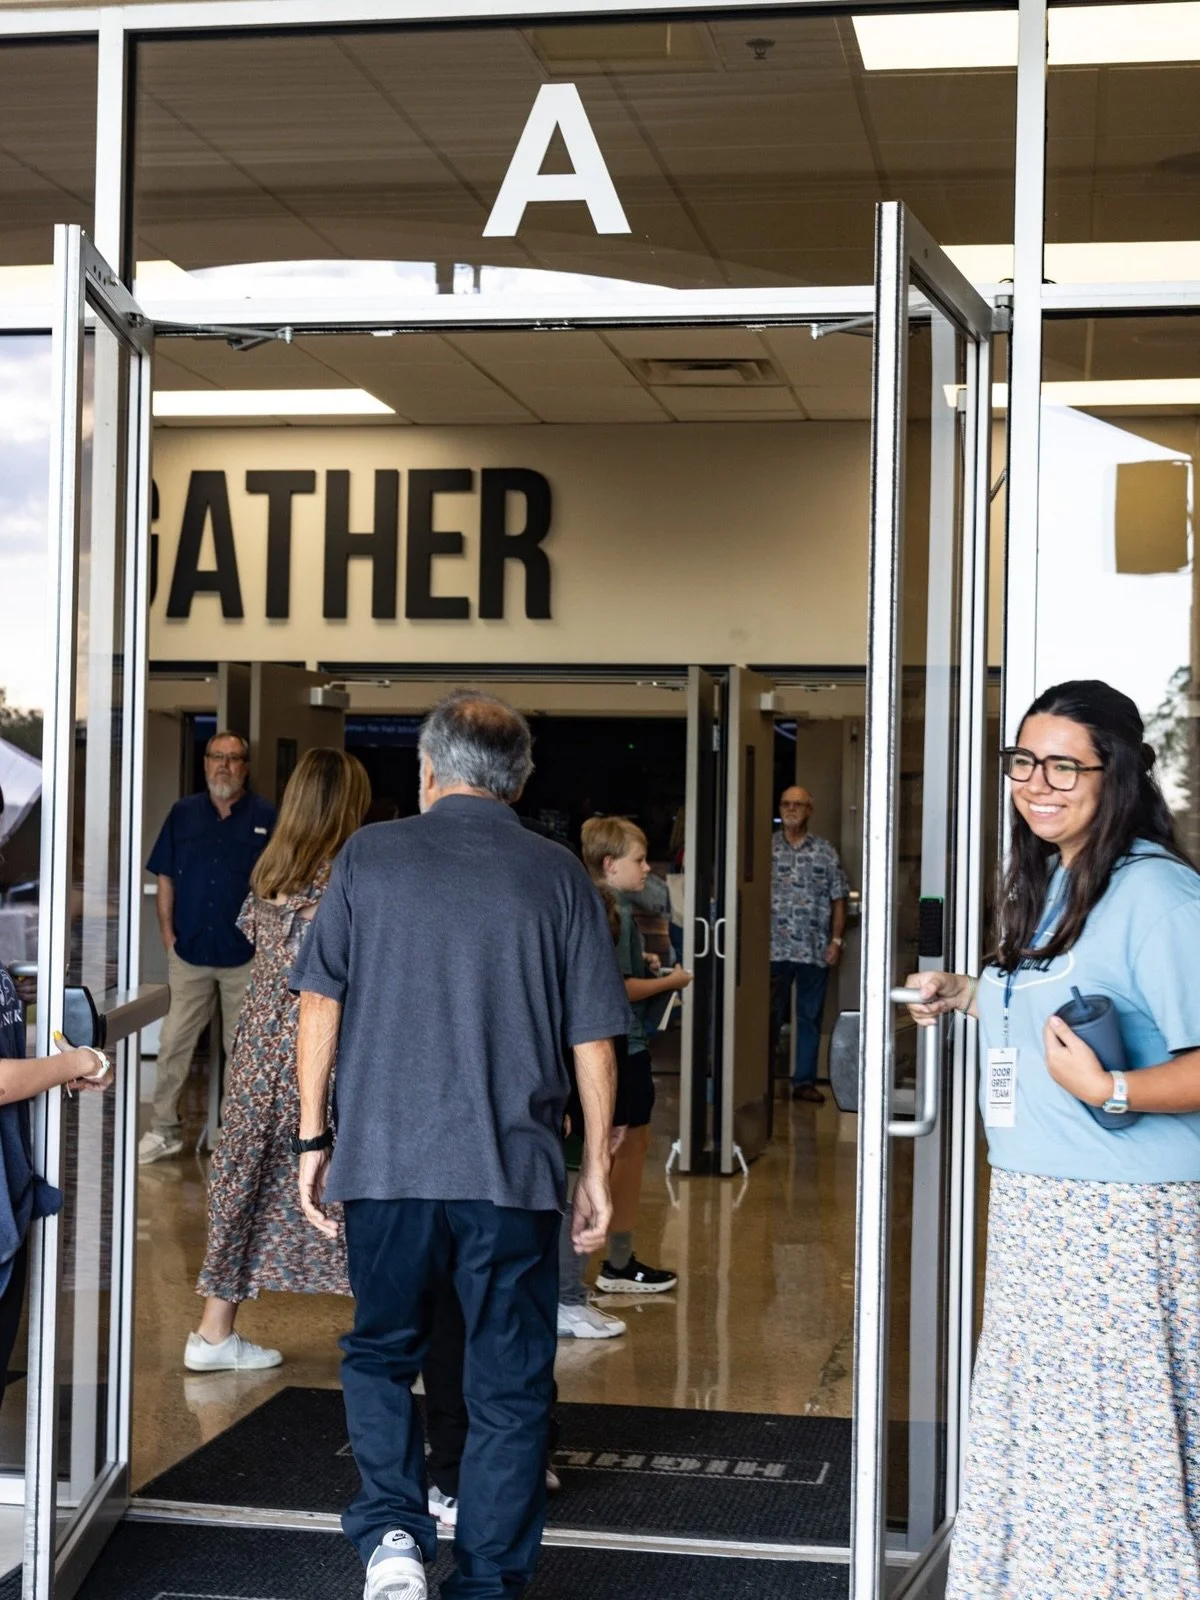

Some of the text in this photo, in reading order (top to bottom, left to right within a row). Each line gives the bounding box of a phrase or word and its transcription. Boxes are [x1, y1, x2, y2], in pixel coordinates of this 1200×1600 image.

[482, 83, 632, 236] A
[150, 468, 553, 620] ATHER
[992, 1068, 1011, 1077] DOOR
[992, 1078, 1011, 1088] GREET
[992, 1089, 1010, 1099] TEAM
[555, 1451, 785, 1478] HIGHL
